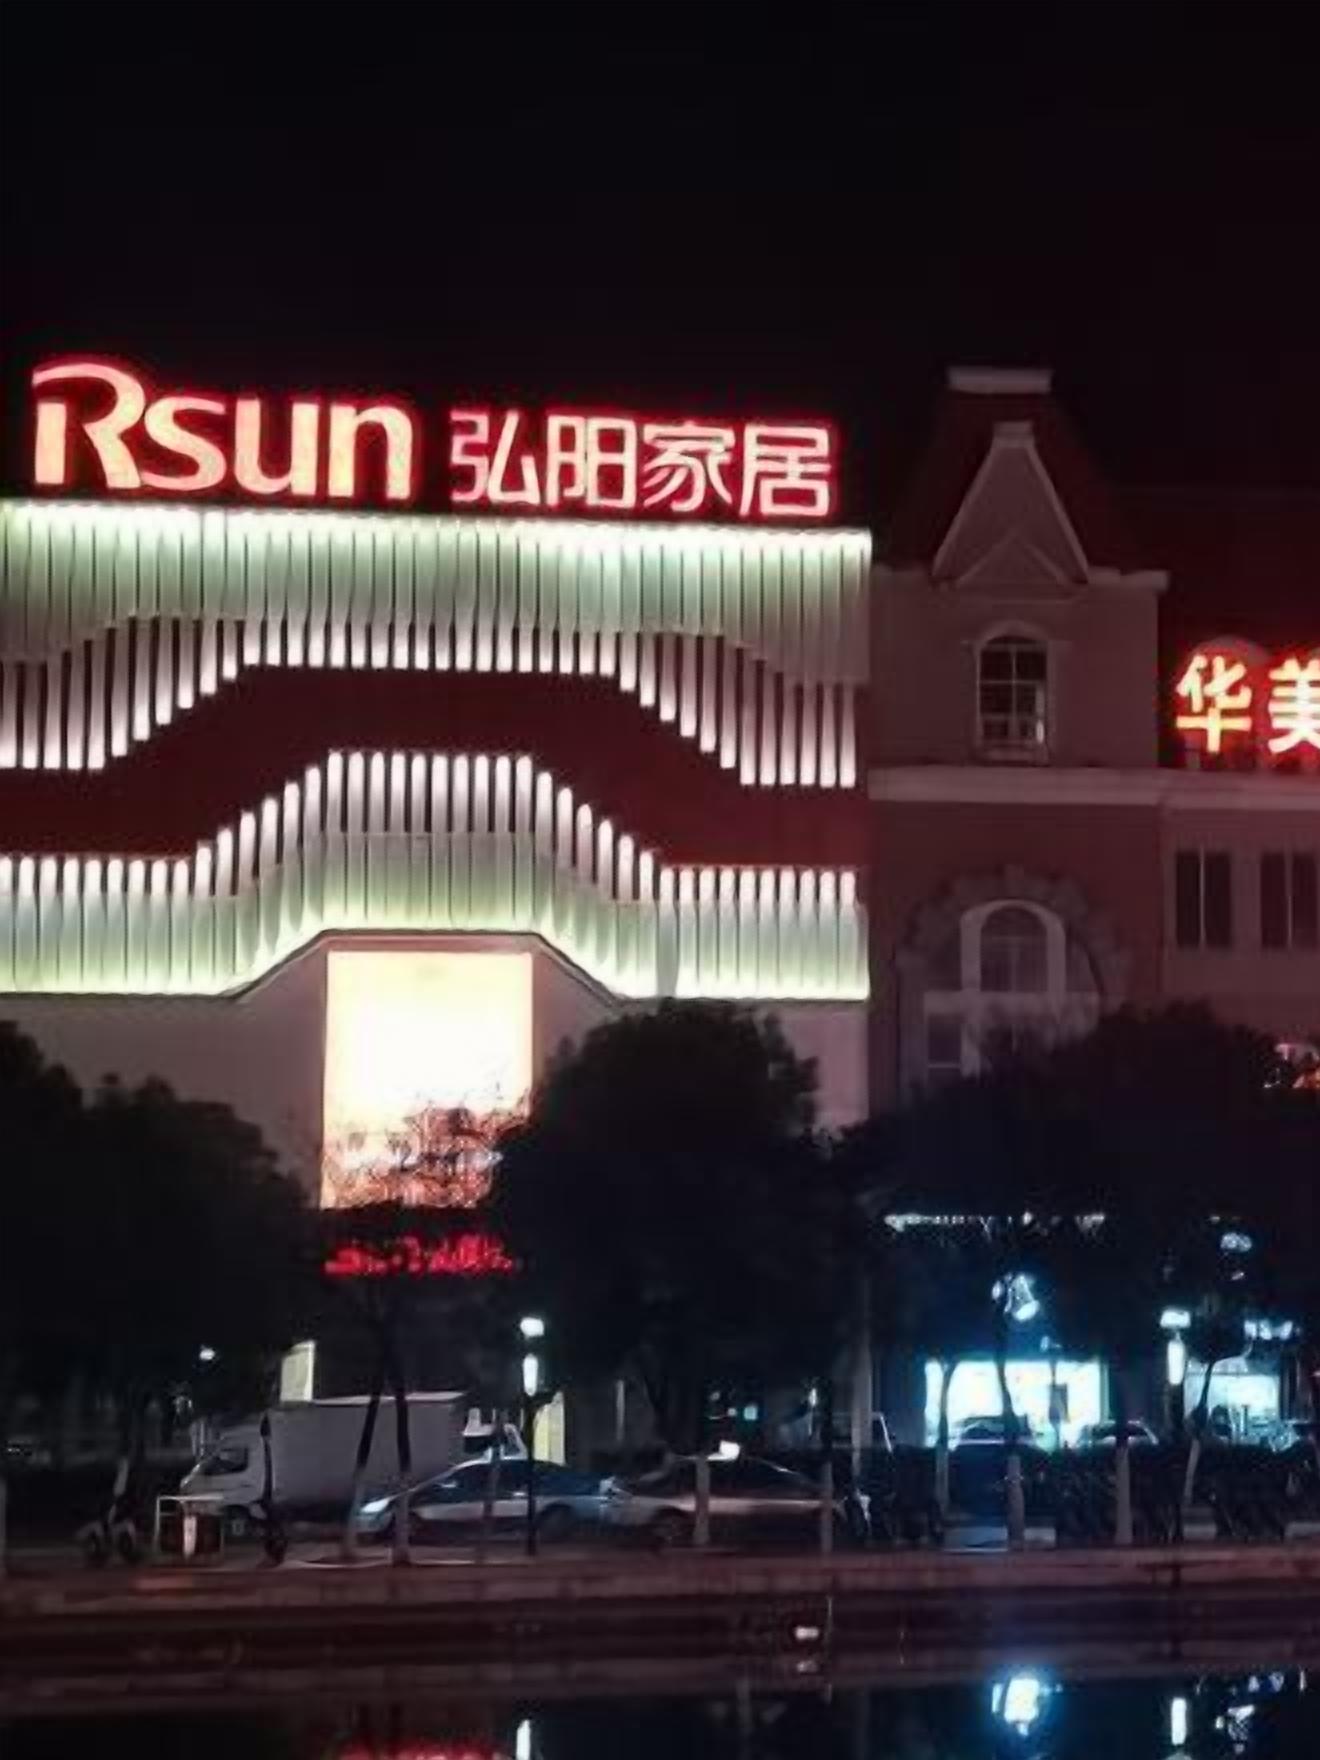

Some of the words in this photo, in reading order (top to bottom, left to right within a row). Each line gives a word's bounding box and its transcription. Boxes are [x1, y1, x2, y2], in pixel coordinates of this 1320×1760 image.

[32, 361, 414, 500] Rsun
[450, 410, 833, 516] 弘阳家居
